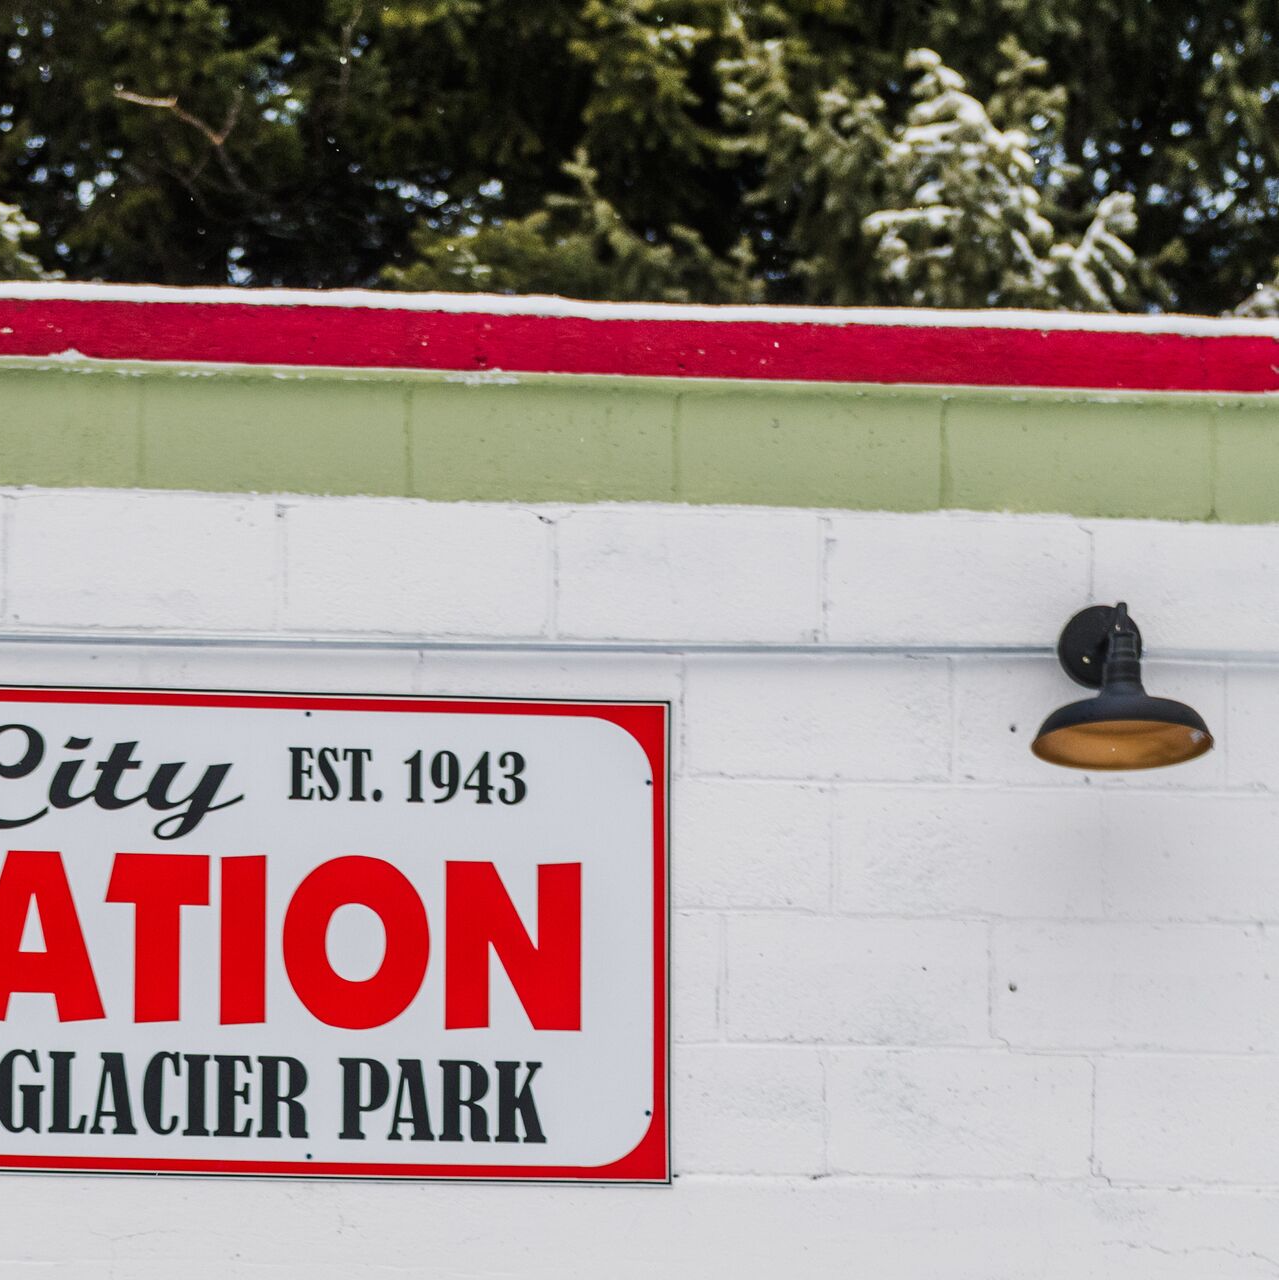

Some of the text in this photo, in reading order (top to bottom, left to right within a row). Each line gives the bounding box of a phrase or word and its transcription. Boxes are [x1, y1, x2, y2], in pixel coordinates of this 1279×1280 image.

[287, 746, 528, 805] EST. 1943
[337, 1056, 548, 1144] PARK
